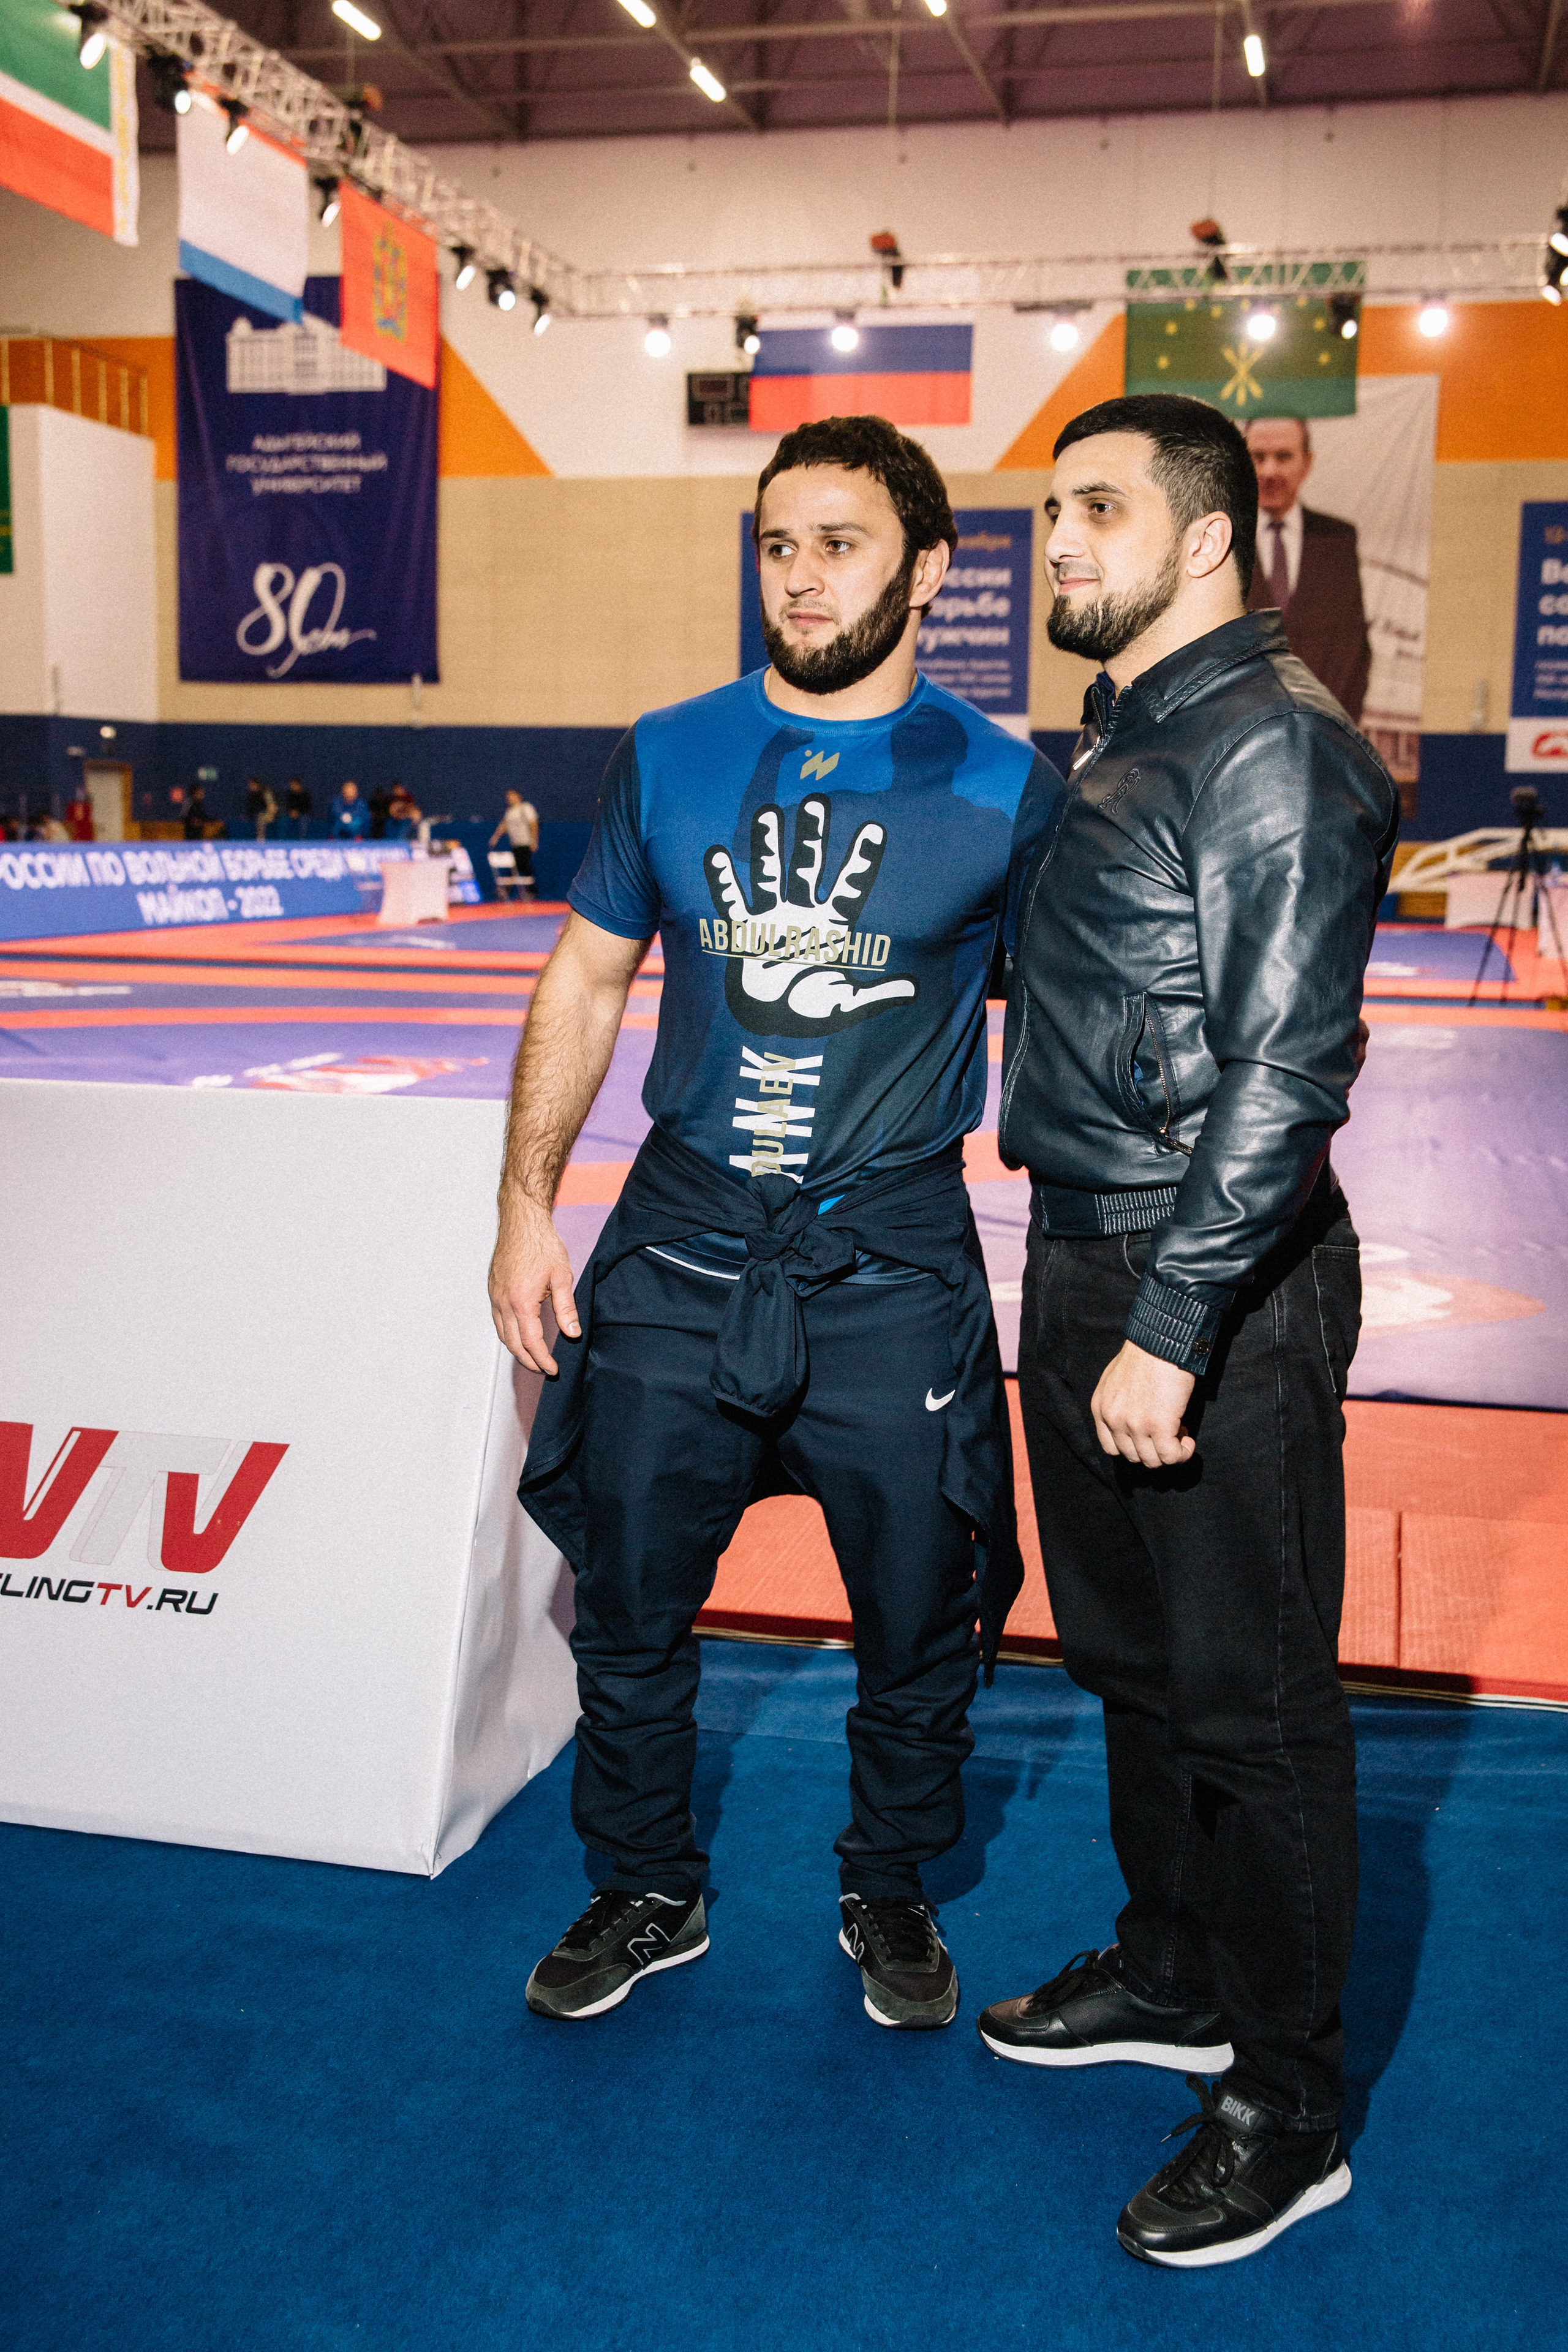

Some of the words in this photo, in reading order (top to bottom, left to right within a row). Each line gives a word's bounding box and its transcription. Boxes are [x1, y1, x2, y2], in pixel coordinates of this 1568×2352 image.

[0, 852, 91, 889] ОССИИ
[86, 851, 126, 886] ПО
[699, 918, 891, 967] ABDULRASHID
[0, 1573, 219, 1615] LINGTV.RU
[1221, 2095, 1256, 2126] BIKK
